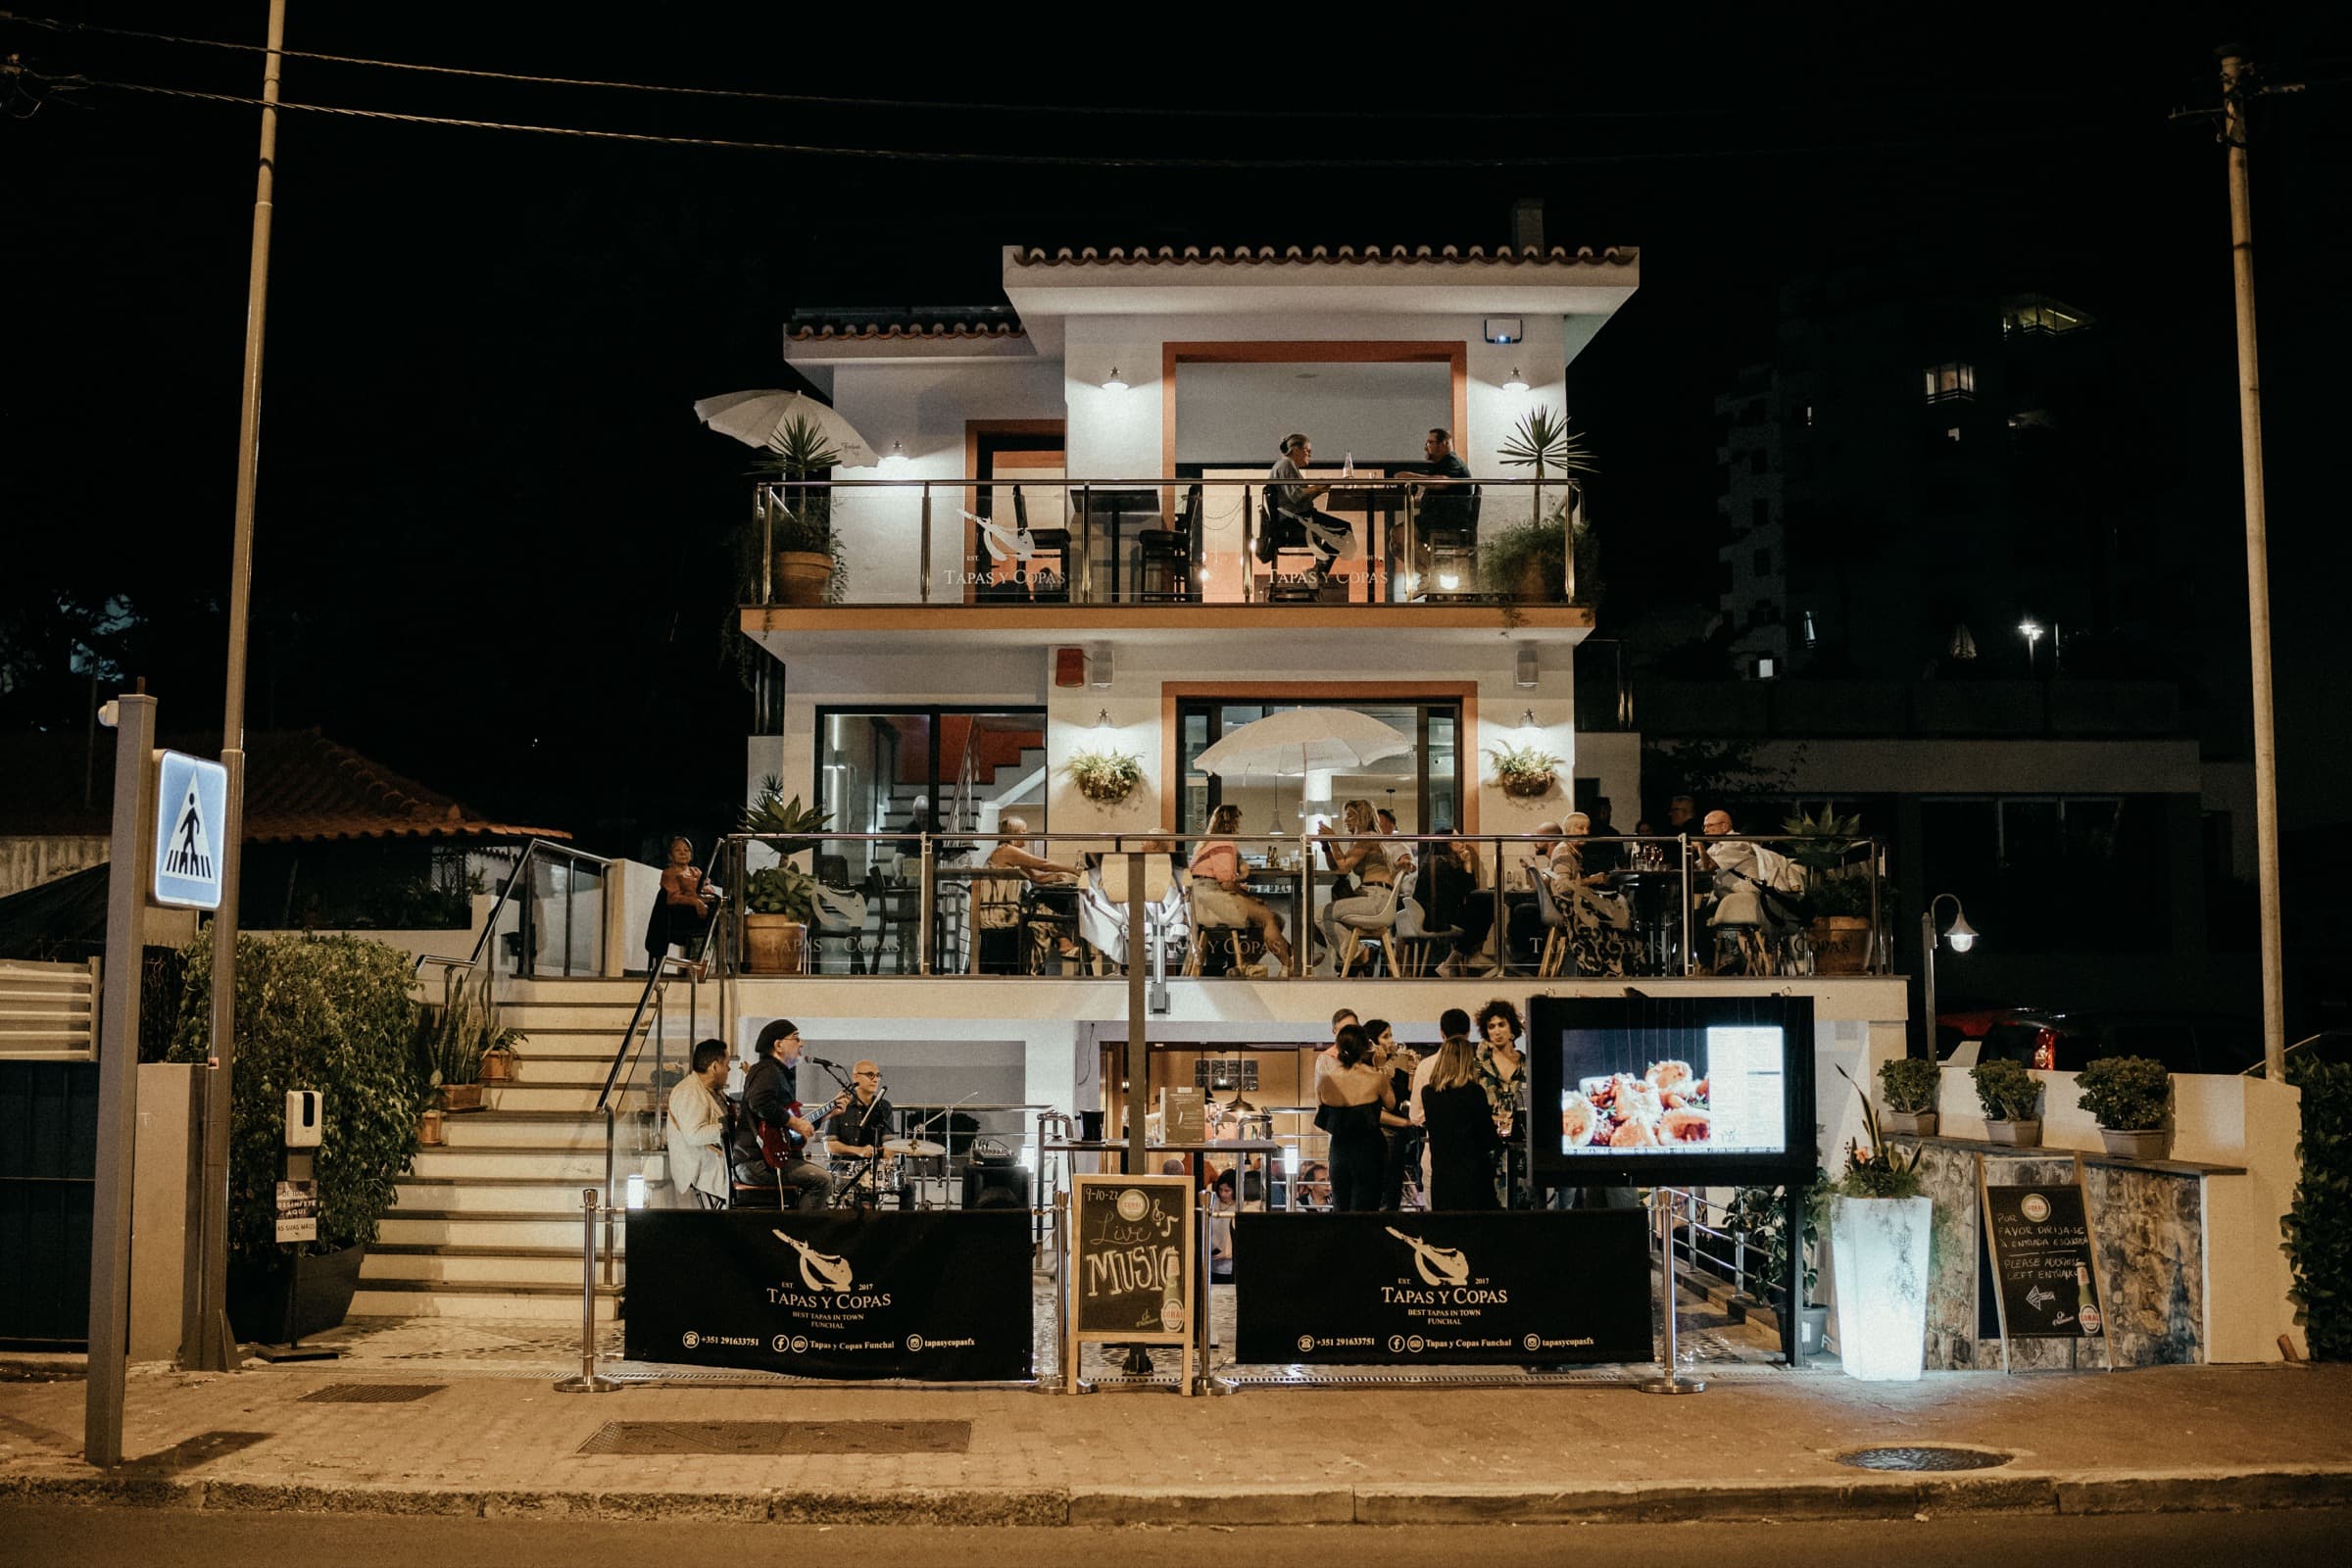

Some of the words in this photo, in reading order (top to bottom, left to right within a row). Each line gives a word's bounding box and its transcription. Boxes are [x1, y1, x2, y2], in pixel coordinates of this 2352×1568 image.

[944, 569, 995, 585] TAPAS
[1000, 571, 1009, 585] Y
[1012, 569, 1066, 585] COPAS
[1268, 568, 1318, 584] TAPAS
[1336, 569, 1389, 585] COPAS
[1206, 940, 1219, 955] Y
[1089, 1210, 1152, 1246] Live
[1997, 1225, 2034, 1238] FAVOR
[2003, 1257, 2041, 1270] PLEASE
[1087, 1246, 1179, 1297] MUSIC
[2006, 1270, 2034, 1281] LEFT
[858, 1283, 874, 1292] 2017
[766, 1287, 818, 1308] TAPAS
[821, 1296, 832, 1309] Y
[836, 1293, 892, 1310] COPAS
[1381, 1286, 1435, 1303] TAPAS
[1438, 1291, 1449, 1304] Y
[1453, 1287, 1508, 1304] COPAS
[810, 1312, 832, 1321] TAPAS
[810, 1320, 846, 1330] FUNCHAL
[701, 1335, 719, 1345] +351
[808, 1340, 832, 1350] Tapas
[839, 1342, 863, 1351] Copas
[864, 1340, 896, 1349] Funchal
[1315, 1338, 1334, 1347] +351
[1425, 1339, 1447, 1349] Tapas
[1455, 1339, 1480, 1349] Copas
[1481, 1338, 1512, 1348] Funchal
